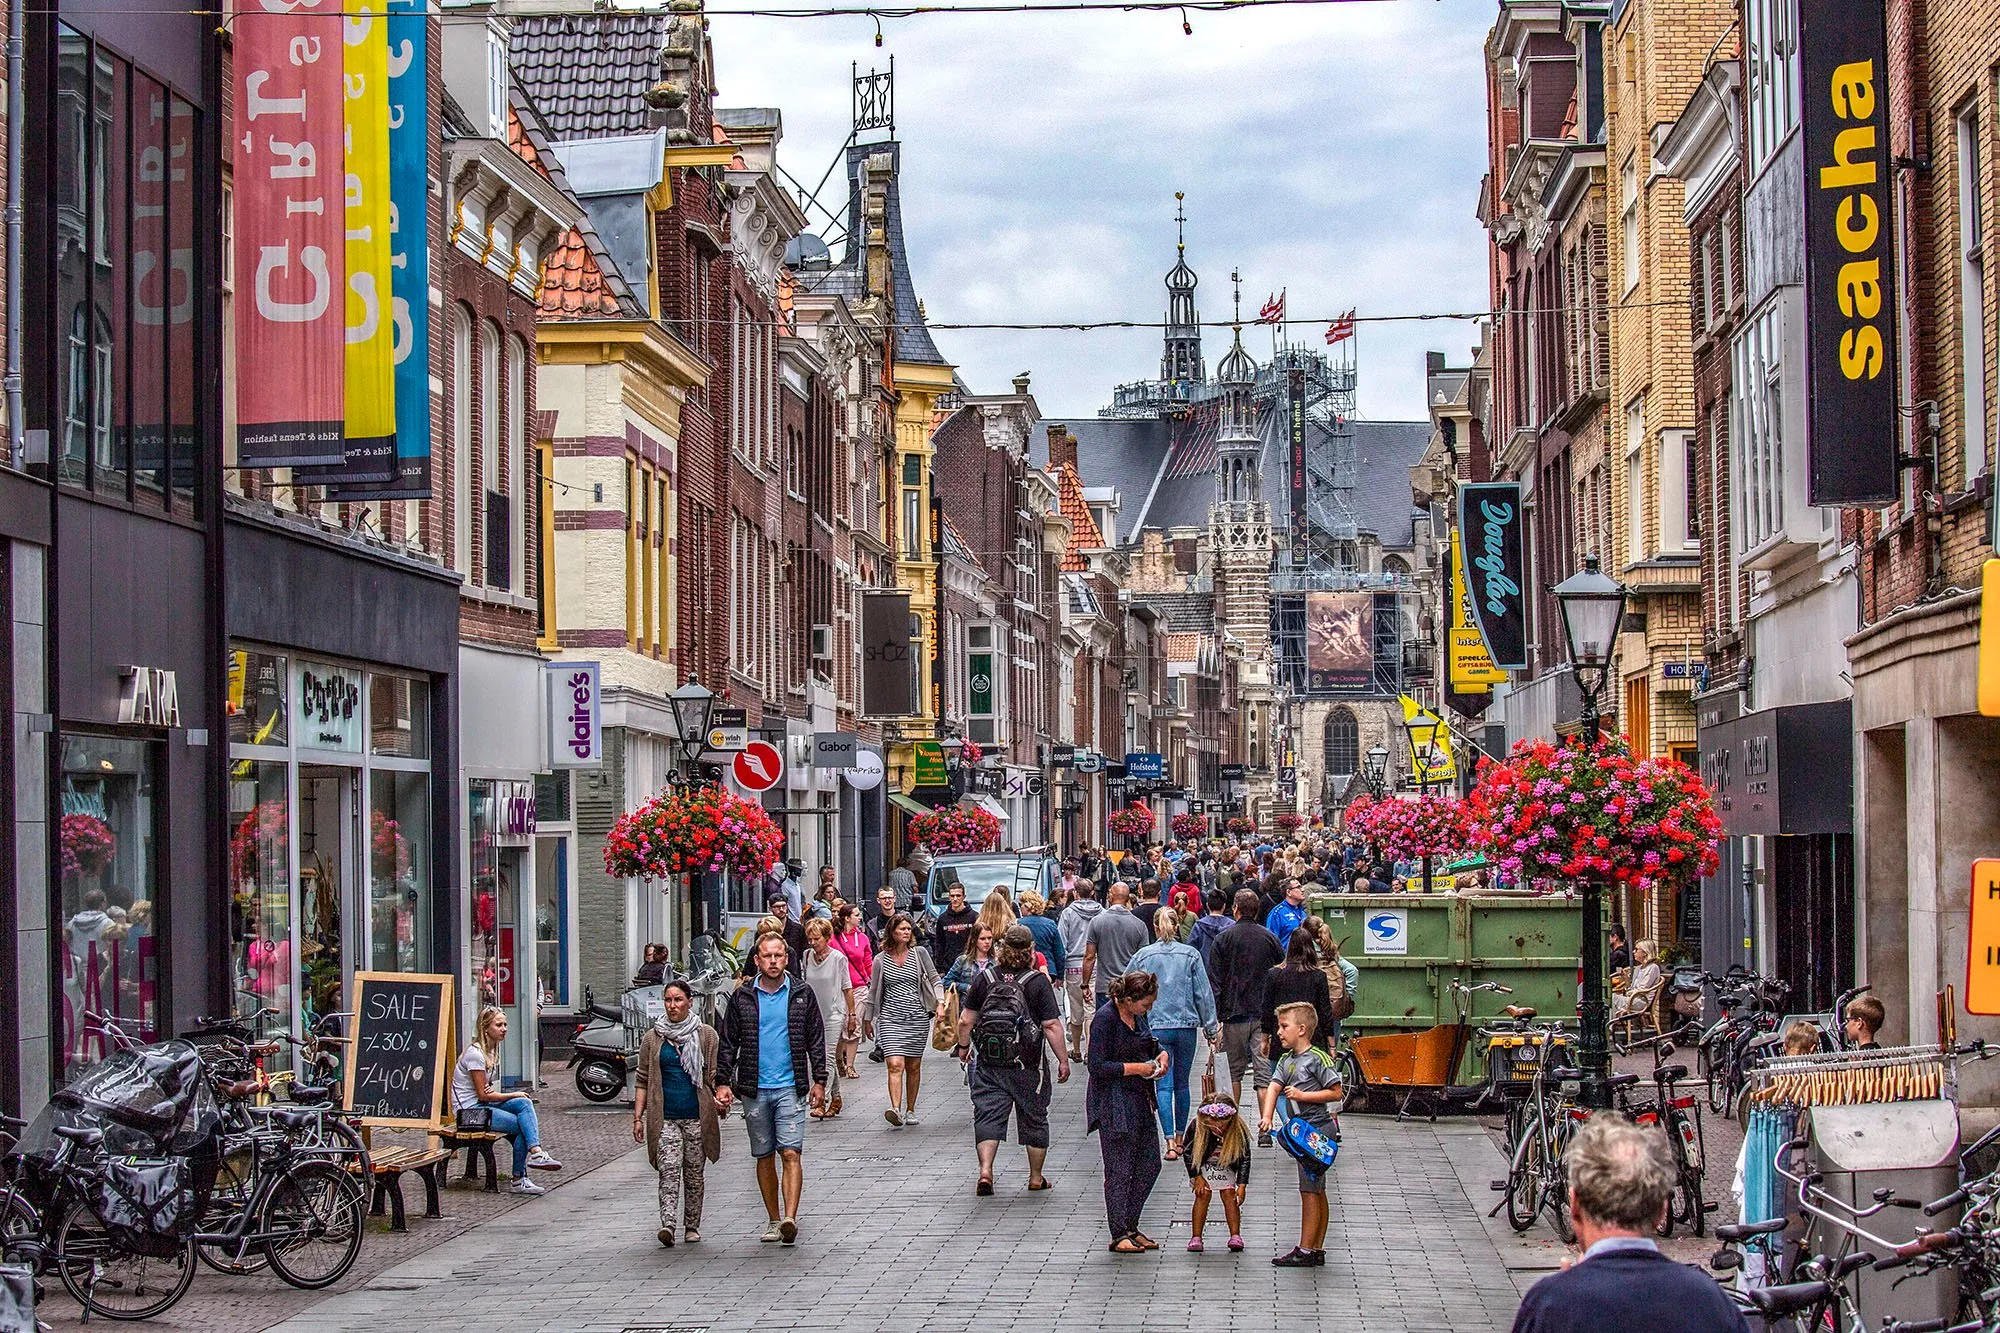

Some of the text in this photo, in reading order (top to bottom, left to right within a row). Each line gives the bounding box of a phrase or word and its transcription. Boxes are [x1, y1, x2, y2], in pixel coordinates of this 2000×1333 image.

[1820, 58, 1884, 381] sacha
[1293, 400, 1301, 428] hemel
[1293, 431, 1301, 443] de
[1475, 500, 1519, 617] Douglas
[120, 665, 181, 727] ZARA
[568, 671, 591, 760] claire's
[818, 741, 851, 752] Gabor
[1130, 763, 1159, 771] Hofstede
[367, 993, 431, 1021] SALE
